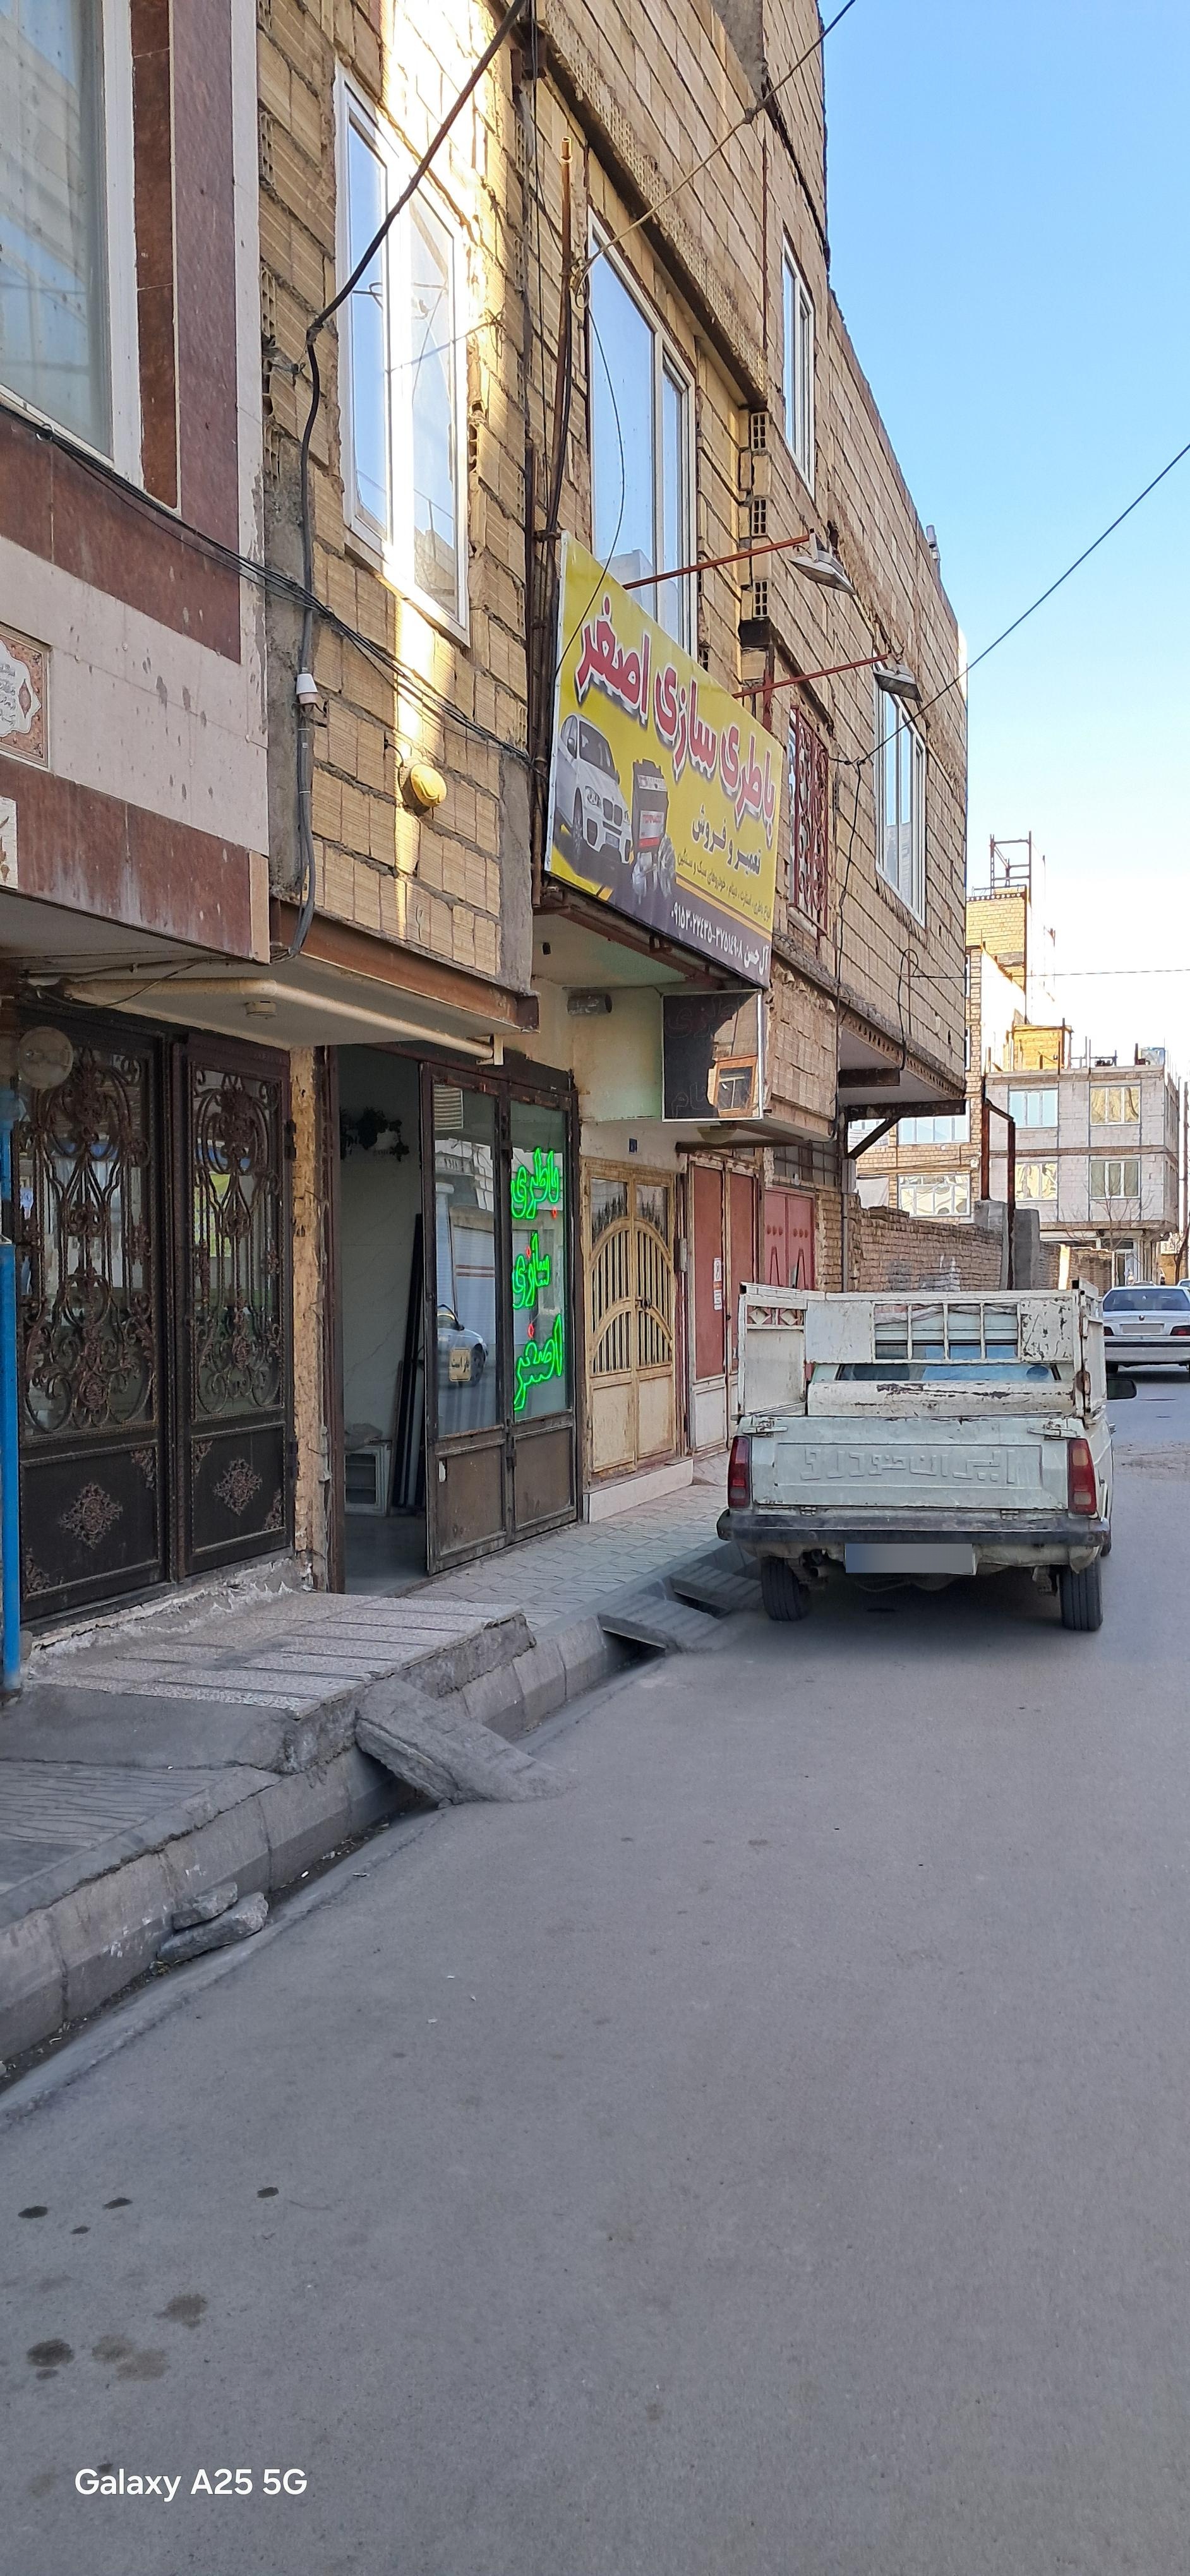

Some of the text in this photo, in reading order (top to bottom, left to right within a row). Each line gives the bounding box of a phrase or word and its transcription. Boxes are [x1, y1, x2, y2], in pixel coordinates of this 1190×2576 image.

[575, 593, 777, 845] باطری سازی اصغر
[692, 804, 726, 852] فروش
[727, 839, 733, 865] و
[735, 849, 762, 876] تعمیر
[511, 1147, 559, 1219] باطری
[512, 1232, 551, 1309] سازی
[514, 1313, 562, 1410] اصغر
